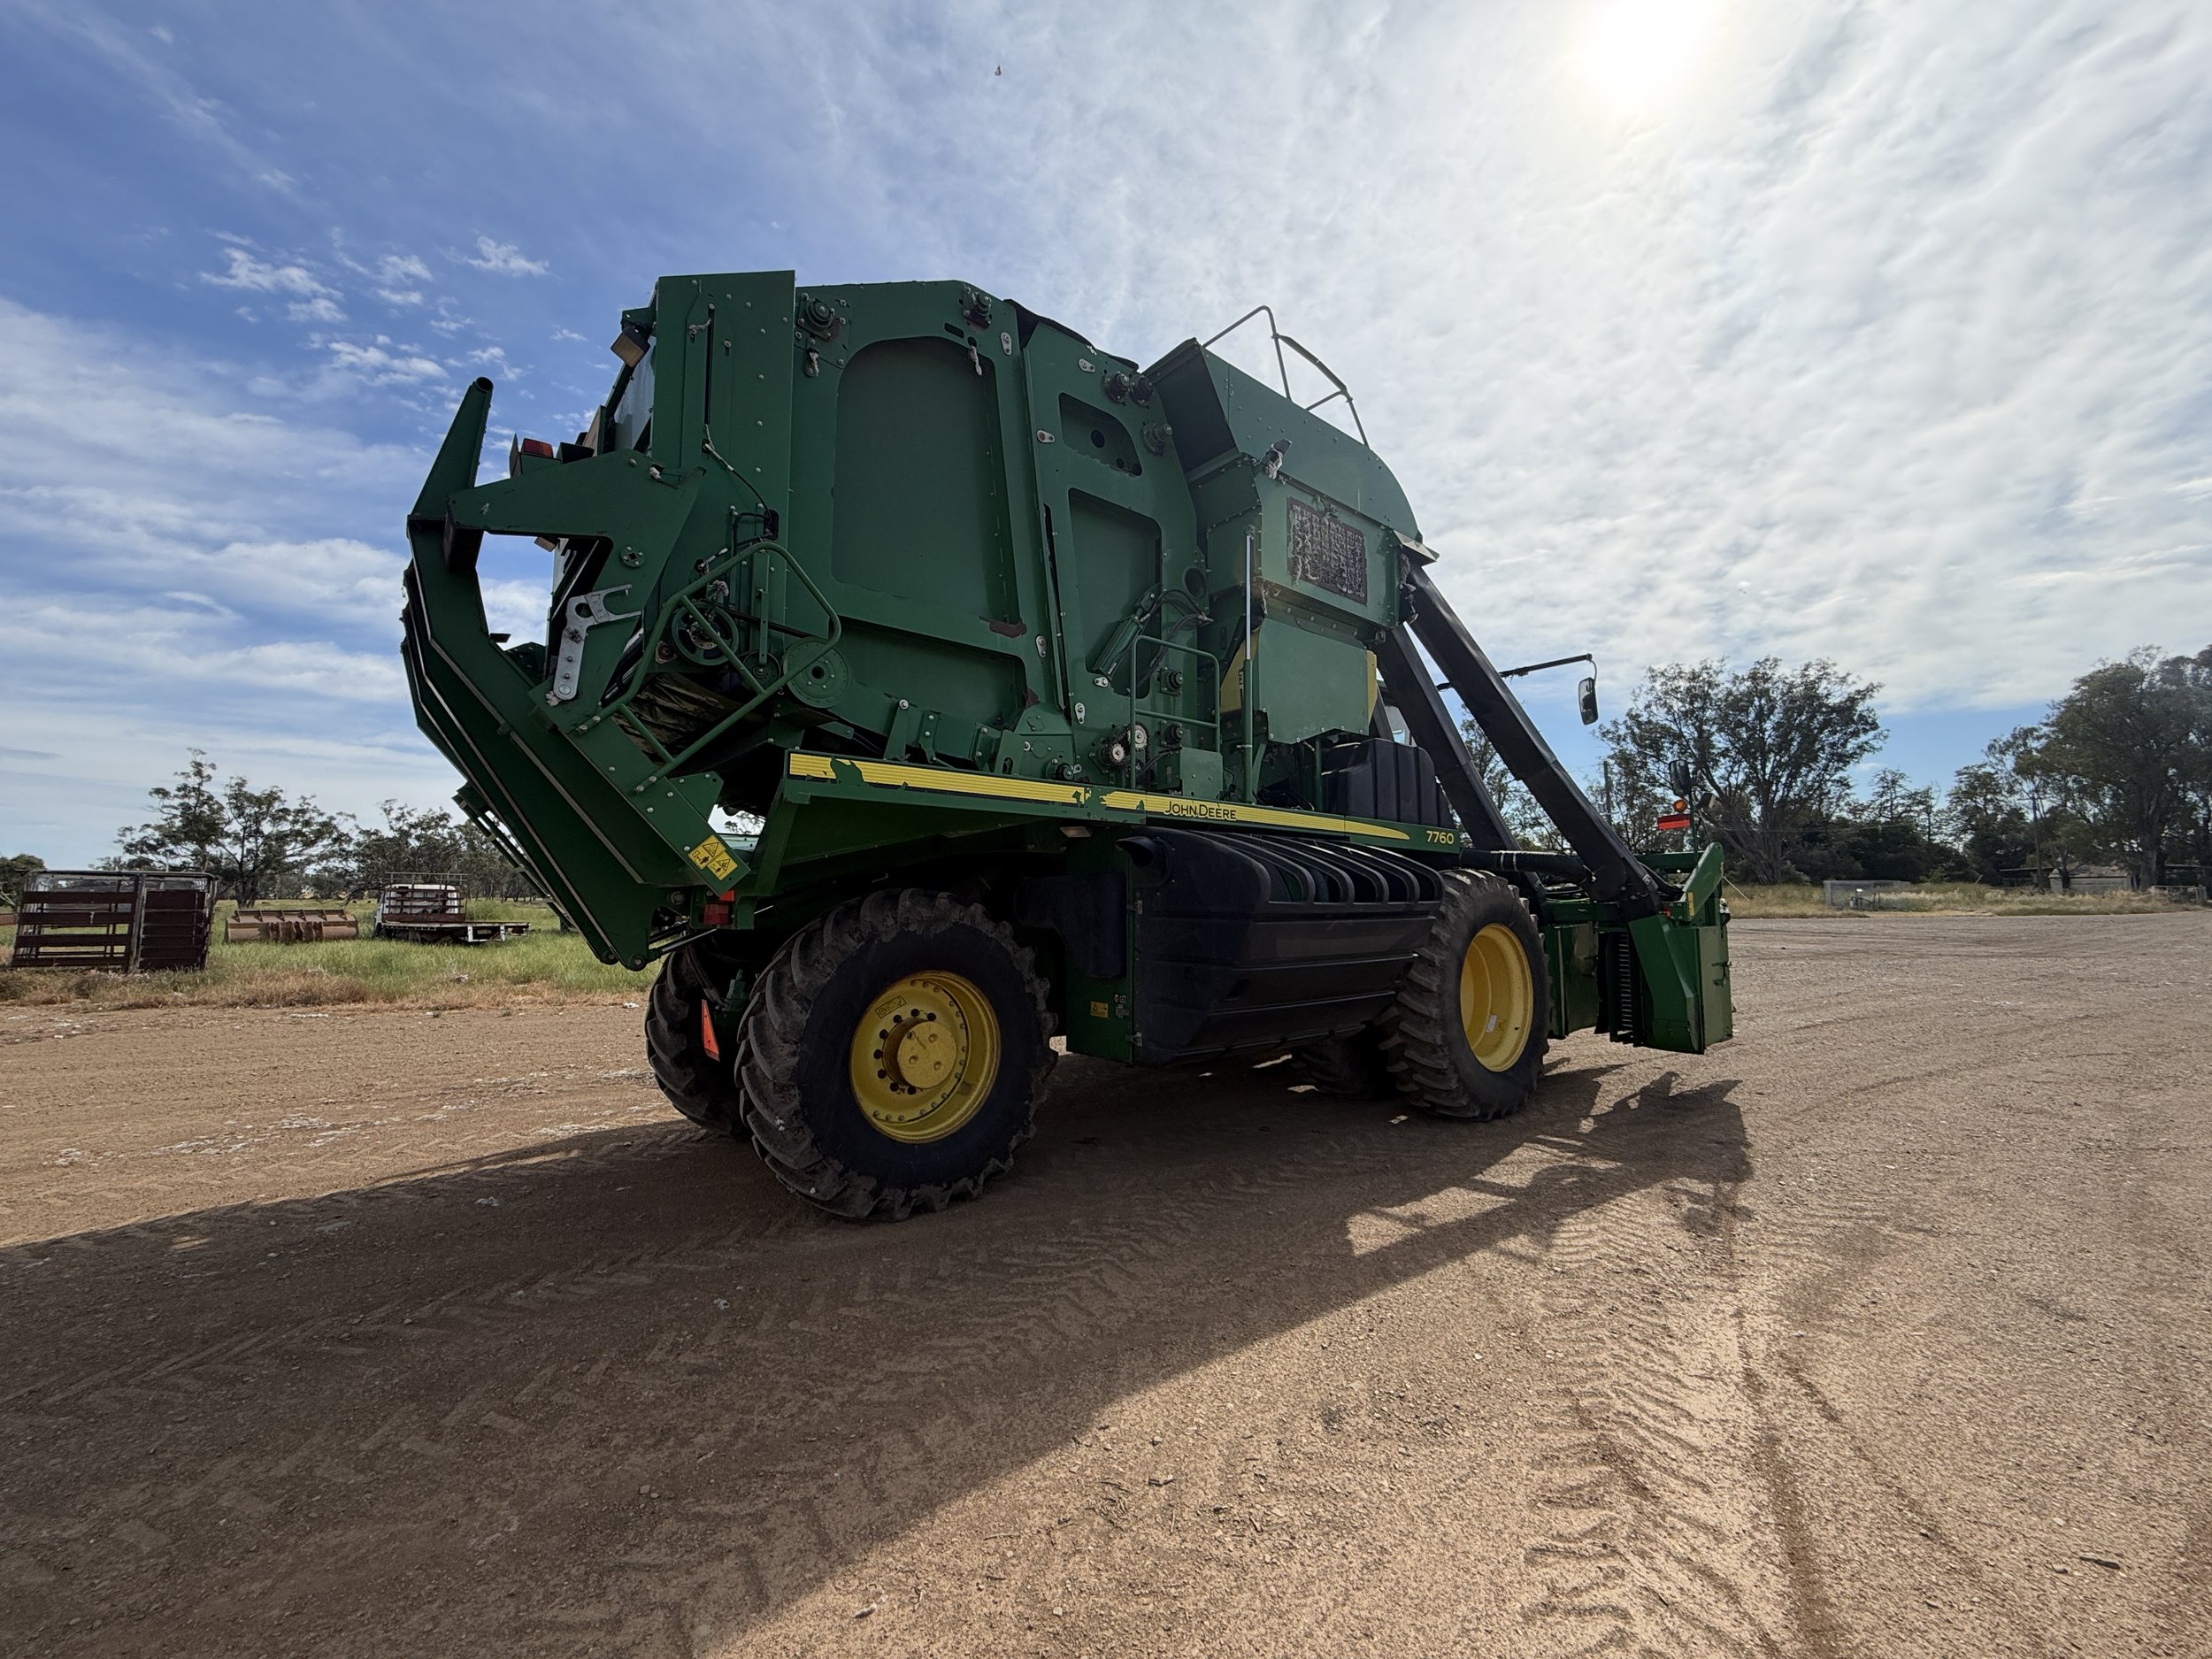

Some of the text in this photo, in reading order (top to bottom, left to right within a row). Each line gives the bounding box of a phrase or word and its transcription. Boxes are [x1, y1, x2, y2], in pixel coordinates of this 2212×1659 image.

[1164, 801, 1237, 819] JOHN DEERE
[1426, 830, 1455, 845] 7760
